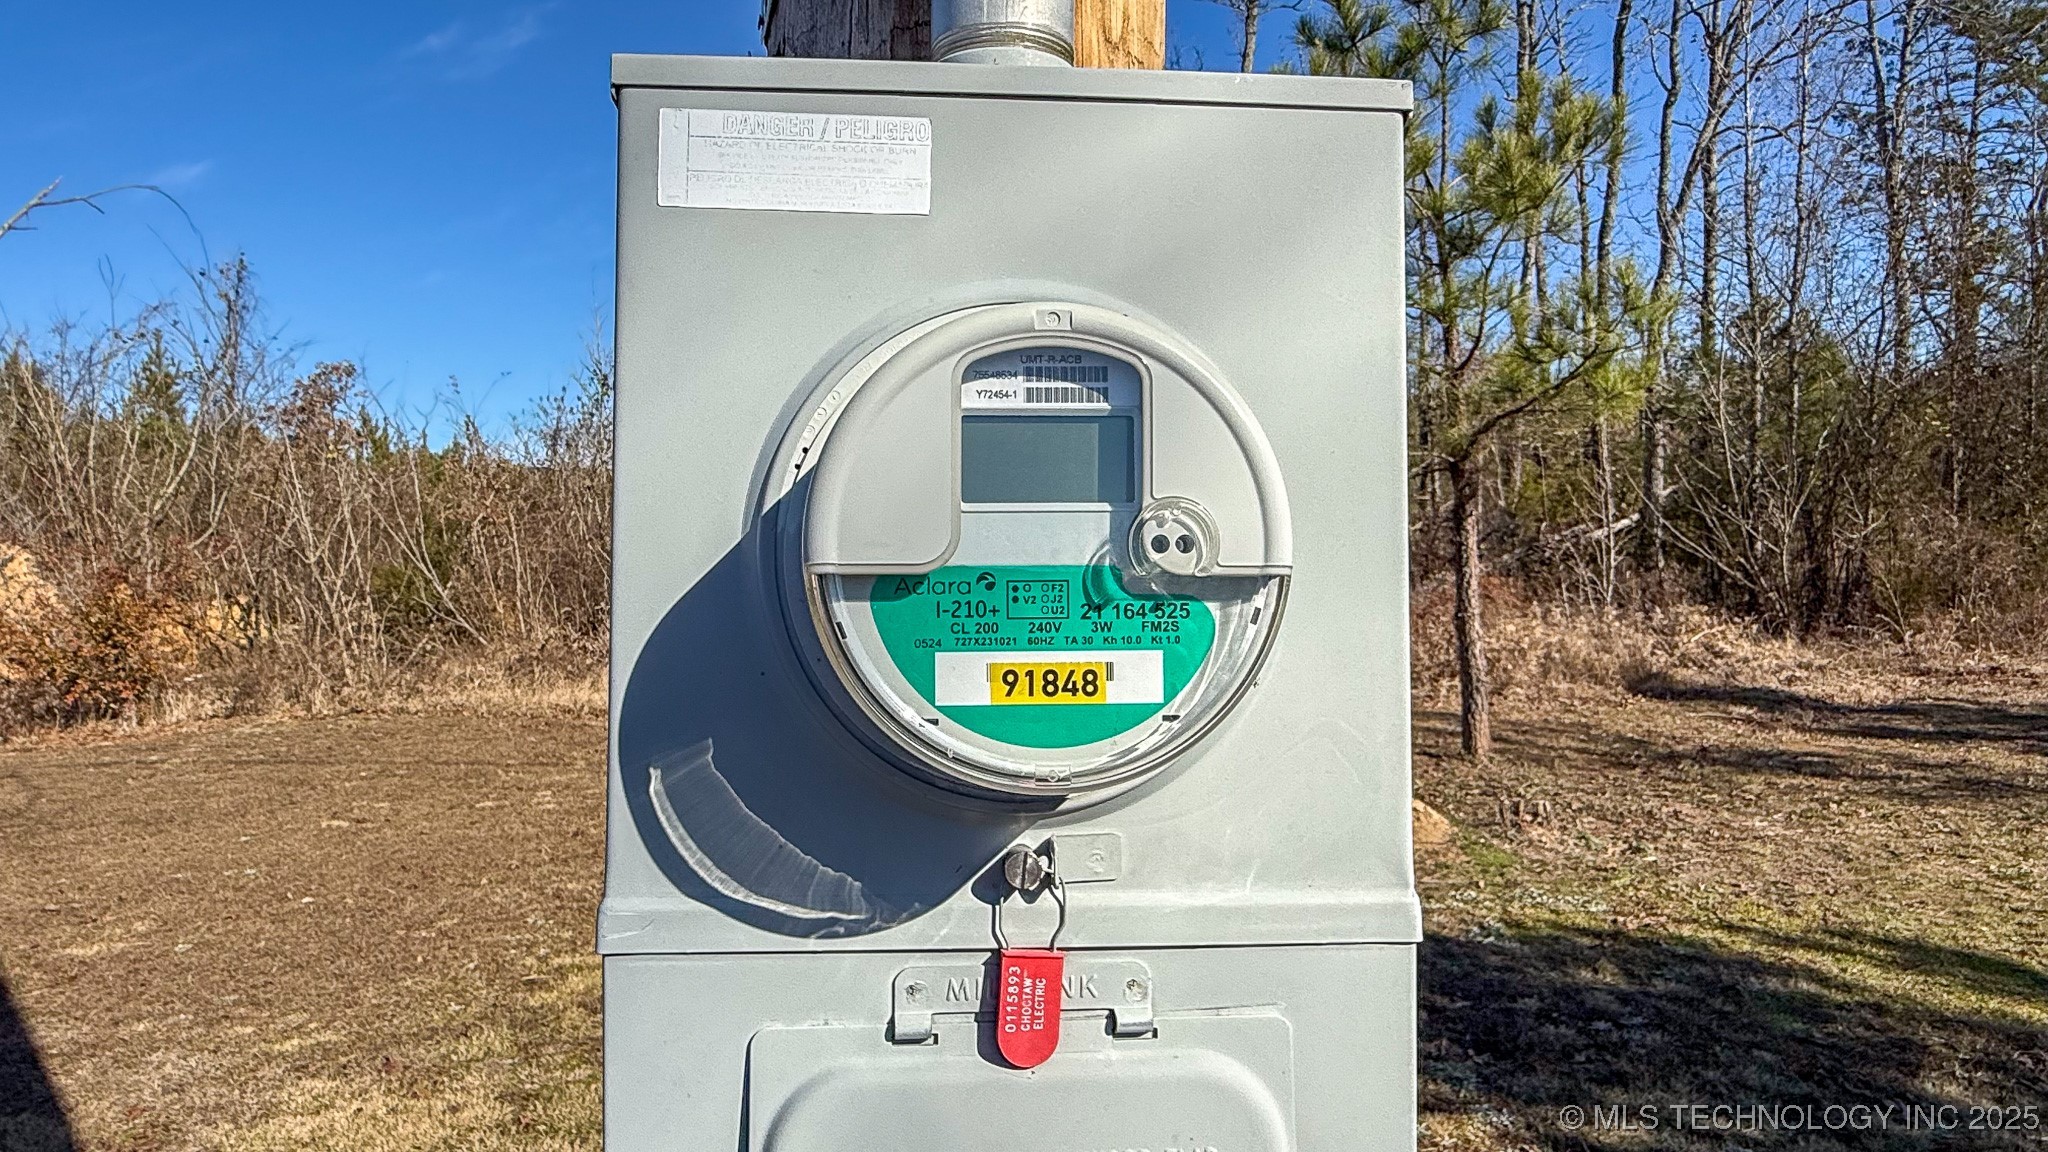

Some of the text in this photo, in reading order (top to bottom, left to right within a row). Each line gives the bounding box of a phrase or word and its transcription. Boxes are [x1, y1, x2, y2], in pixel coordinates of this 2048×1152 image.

[723, 113, 814, 137] DANGER
[835, 117, 931, 142] PELIGRO
[1019, 354, 1082, 364] UMT-R-ACB
[976, 389, 1017, 400] Y72454-1
[894, 577, 971, 596] Aclara
[1023, 595, 1037, 604] V2
[936, 600, 1000, 619] I-210+
[1080, 602, 1191, 620] 21 164 525
[950, 620, 1180, 634] CL 200 240V 3W FM2S
[914, 635, 1181, 649] 0524 727X231021 60HZ TA 30 Kh 10.0 Kt 1.0
[1001, 669, 1099, 698] 91848
[946, 974, 1098, 1002] MINK
[1005, 966, 1021, 1033] 0115893
[1021, 977, 1034, 1032] CHOCTAW
[1033, 977, 1047, 1030] ELECTRIC
